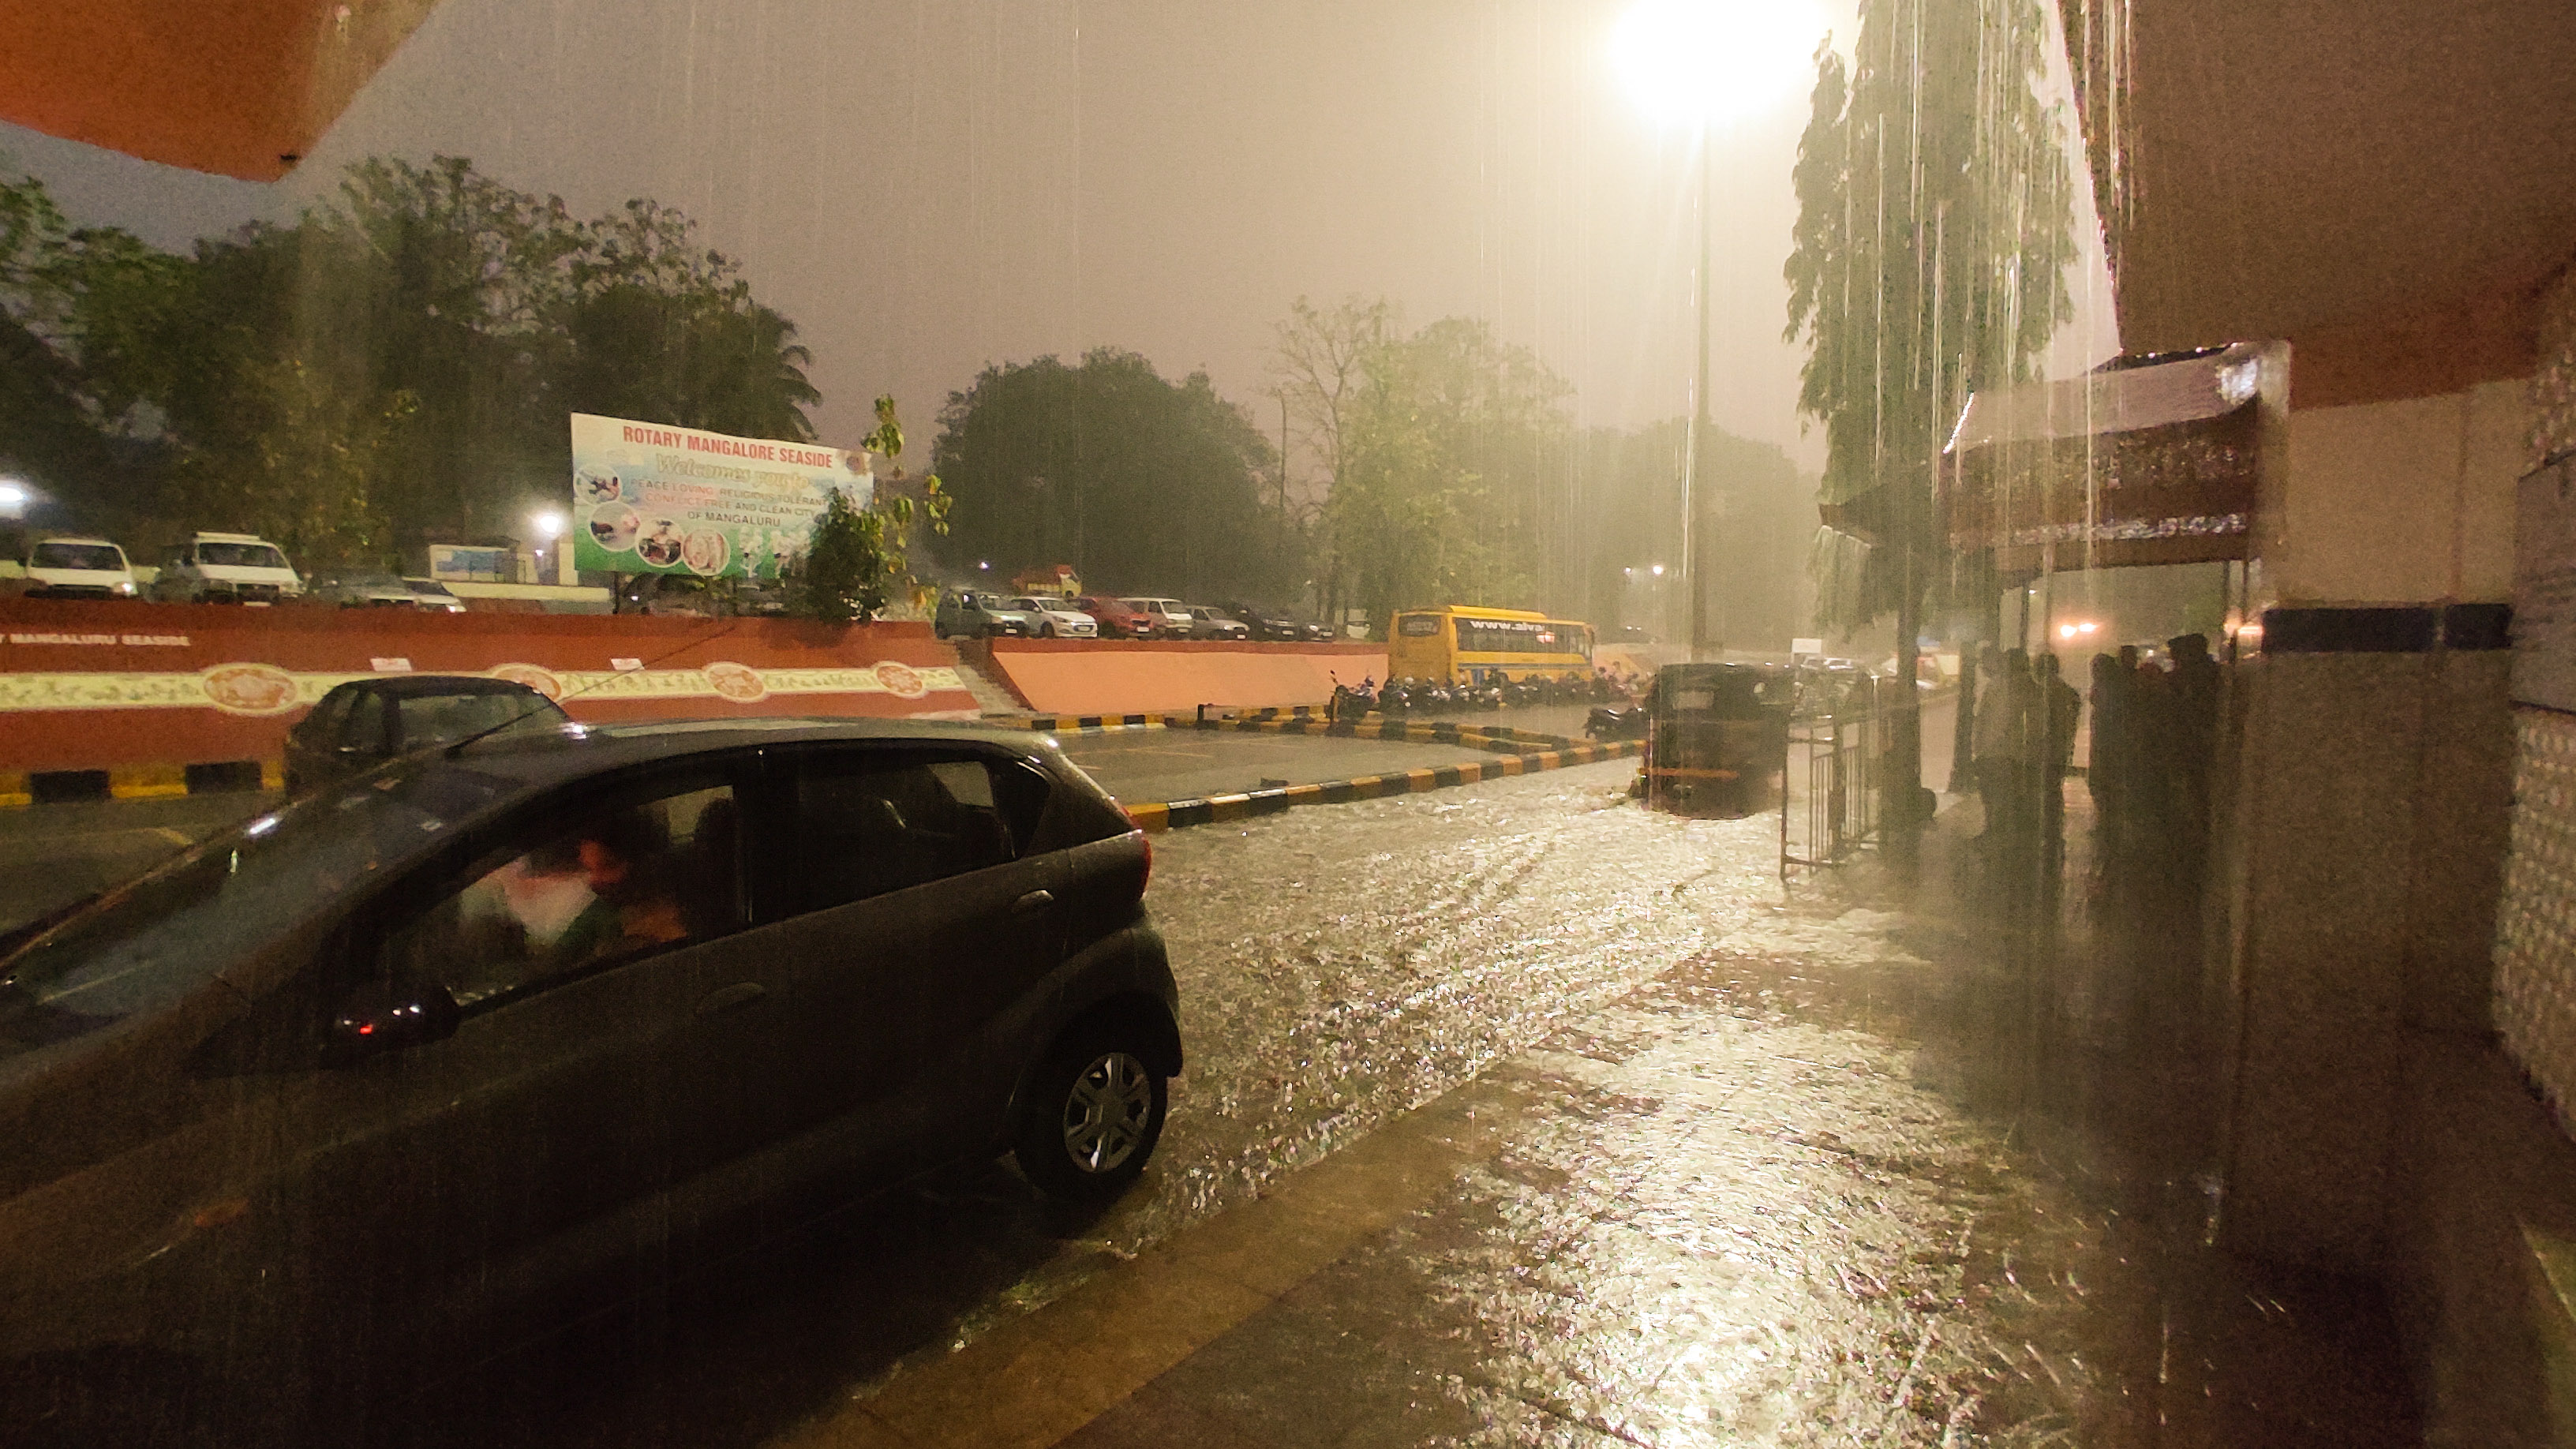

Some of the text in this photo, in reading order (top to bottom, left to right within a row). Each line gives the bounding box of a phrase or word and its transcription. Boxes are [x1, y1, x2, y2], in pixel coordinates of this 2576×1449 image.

[623, 426, 833, 468] ROTARY MANGALORE SEASIDE
[656, 453, 751, 484] Welcomes
[631, 478, 828, 506] PEACE LOVING RELIGIOUS TOLERANT
[687, 511, 781, 527] OF MANGALURU
[704, 499, 731, 509] FREE
[736, 502, 756, 511] AND
[759, 504, 792, 515] CLEAN
[795, 507, 816, 517] CITY
[10, 634, 117, 645] MANGALURU
[122, 635, 191, 646] SEASIDE
